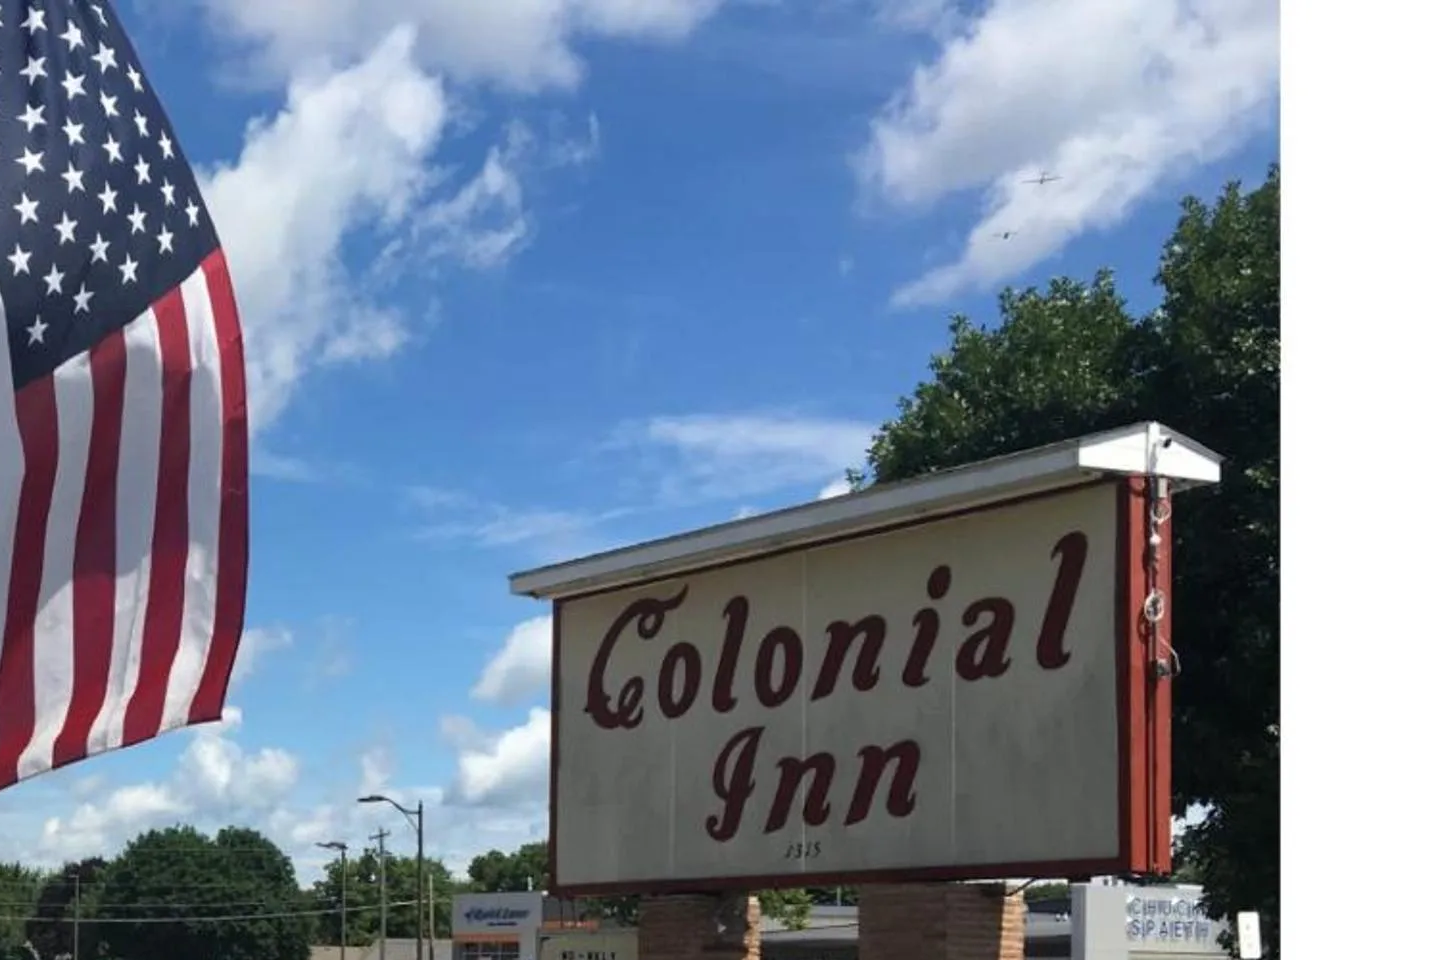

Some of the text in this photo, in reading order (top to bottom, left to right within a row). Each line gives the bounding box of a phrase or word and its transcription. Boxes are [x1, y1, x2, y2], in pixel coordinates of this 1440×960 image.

[584, 530, 1089, 730] Colonial
[705, 726, 922, 842] Inn
[784, 841, 822, 859] 1315
[1126, 918, 1211, 940] SPAETH
